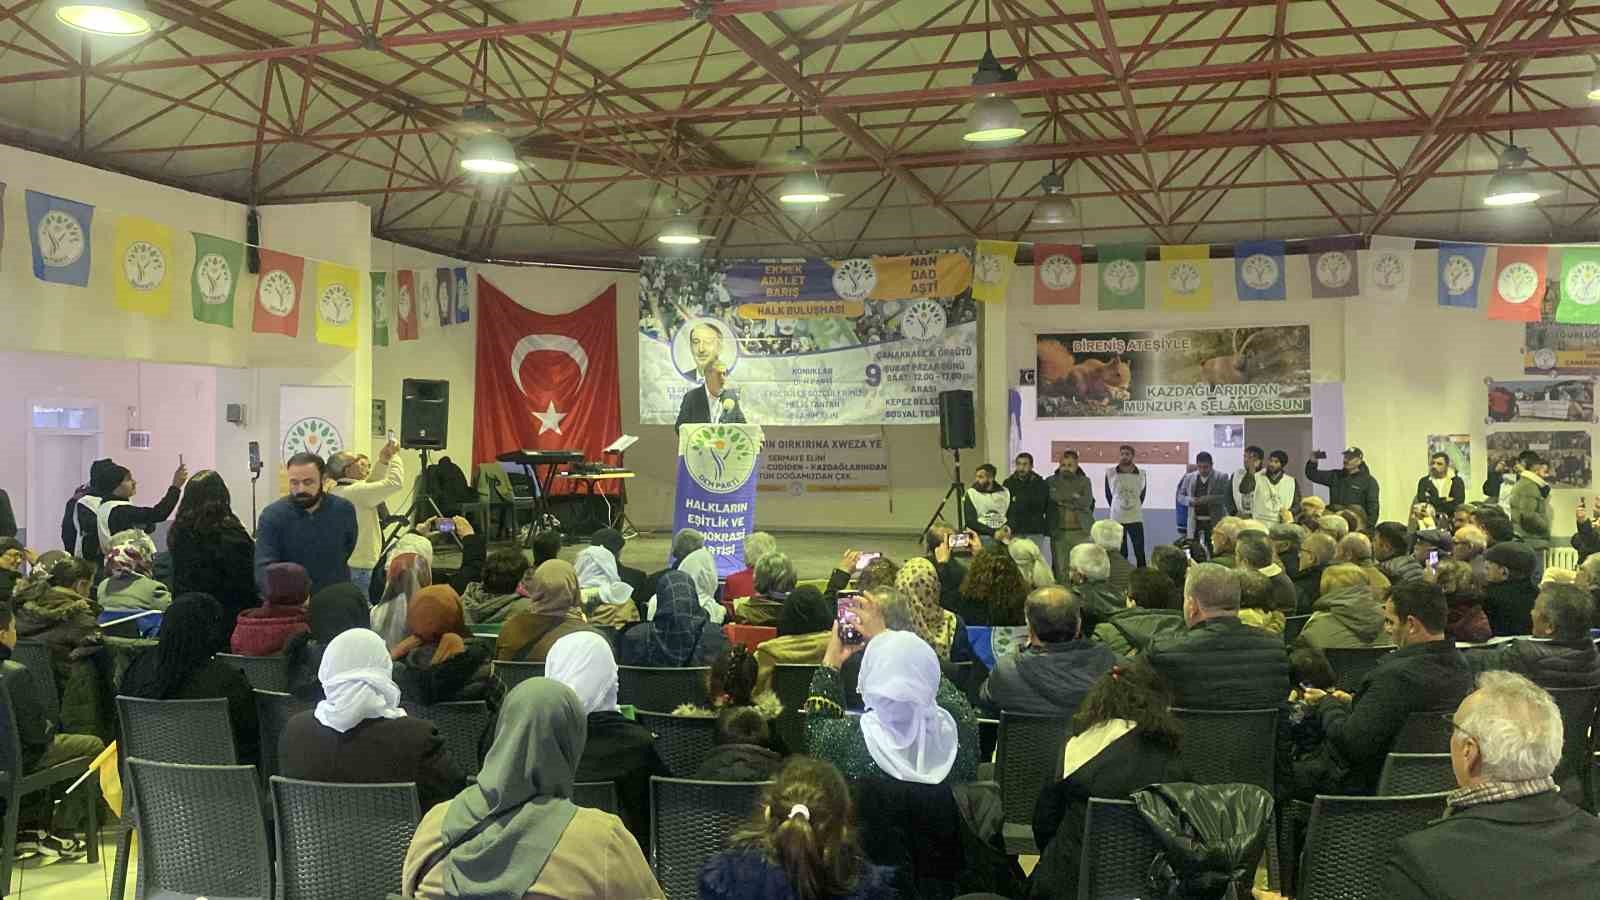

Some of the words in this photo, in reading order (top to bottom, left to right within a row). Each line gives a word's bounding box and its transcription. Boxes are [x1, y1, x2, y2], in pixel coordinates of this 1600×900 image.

[760, 275, 806, 286] ADALET
[911, 269, 937, 280] DAD
[766, 287, 800, 299] BARIŞ
[758, 303, 782, 316] HALK
[784, 304, 845, 317] BULUŞMASI
[1072, 338, 1125, 353] DİRENİŞ
[1127, 337, 1191, 352] ATEŞİYLE
[865, 363, 881, 387] 9
[911, 385, 936, 394] ARASI
[1146, 381, 1280, 398] KAZDAĞLARINDAN
[885, 398, 912, 408] KEPEZ
[1123, 401, 1197, 414] MUNZUR'A
[1201, 400, 1250, 412] SELAM
[1253, 400, 1304, 412] OLSUN
[885, 408, 916, 419] SOSYAL
[831, 439, 867, 449] XWEZA
[869, 439, 882, 449] YE
[716, 478, 740, 489] PARTİ
[685, 498, 748, 513] HALKLARIN
[687, 514, 729, 529] EŞİTLİK
[731, 516, 745, 527] VE
